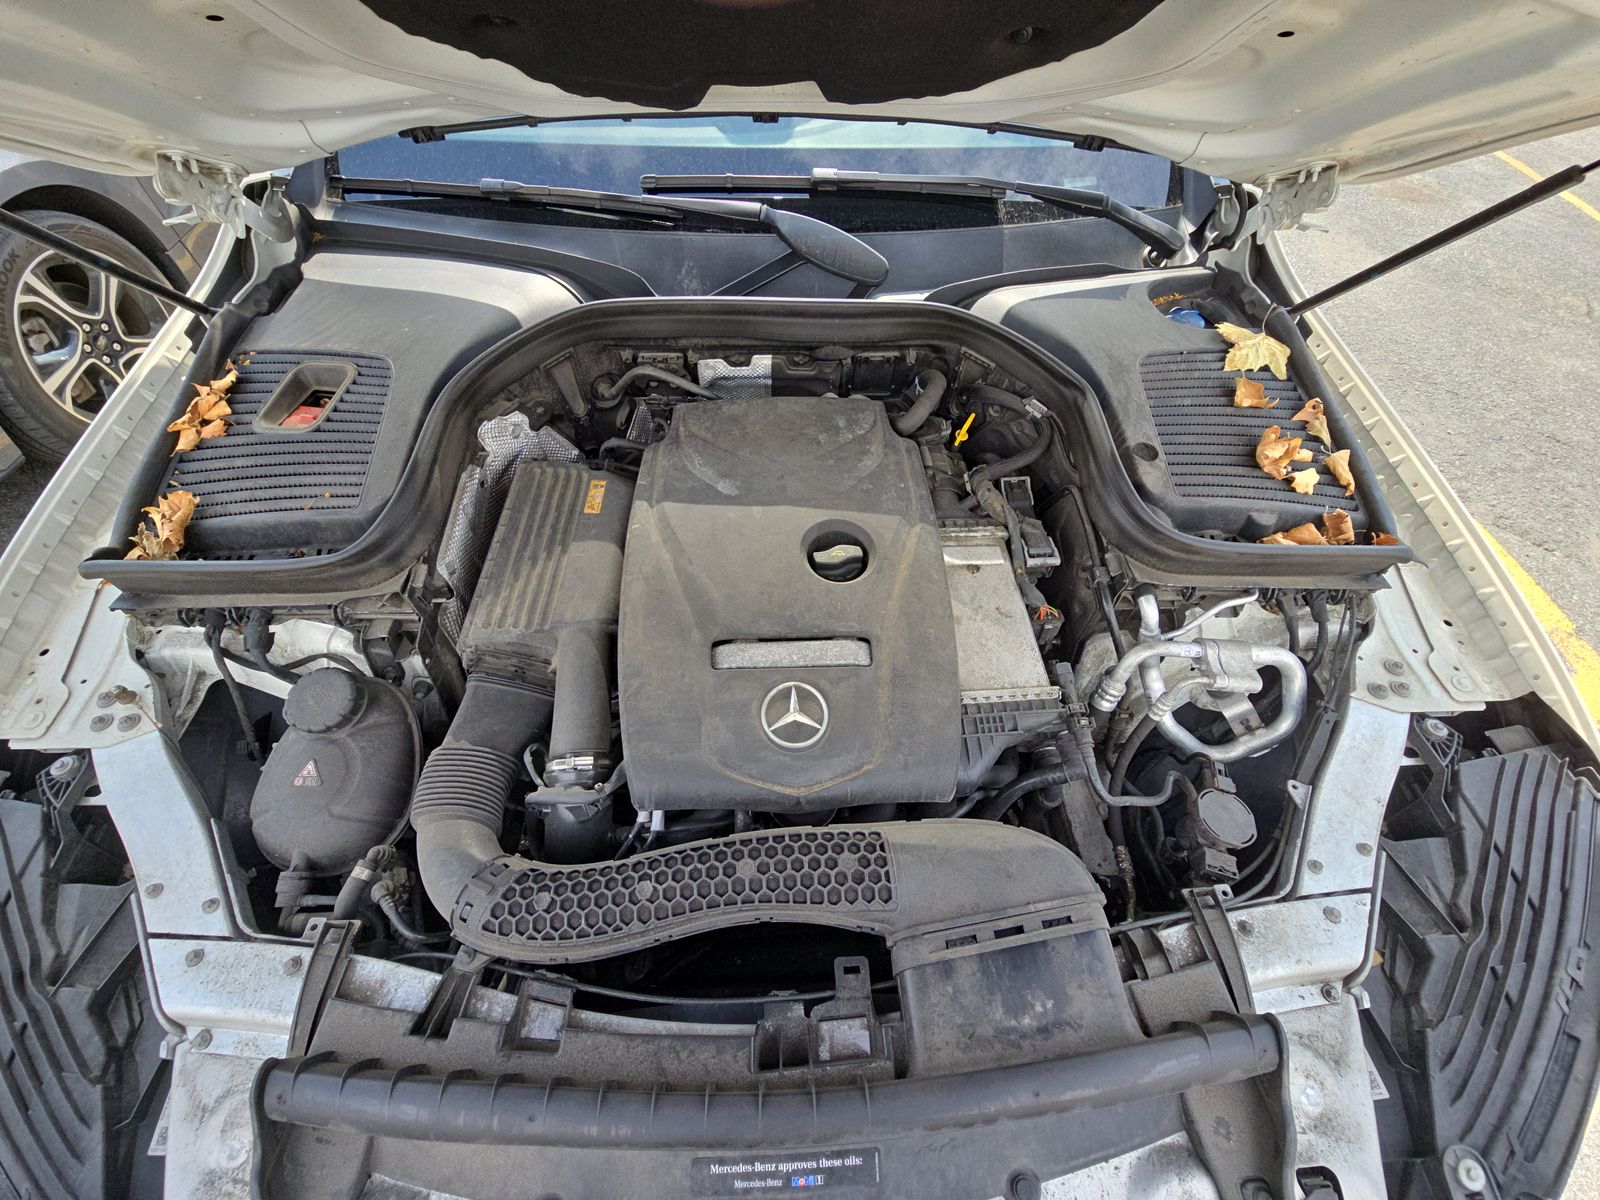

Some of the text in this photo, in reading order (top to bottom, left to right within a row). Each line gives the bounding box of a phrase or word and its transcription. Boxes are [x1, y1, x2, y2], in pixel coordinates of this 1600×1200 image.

[710, 1156, 863, 1174] Mercedes-Benz approves these oils:
[734, 1179, 782, 1189] Mercedes-Benz
